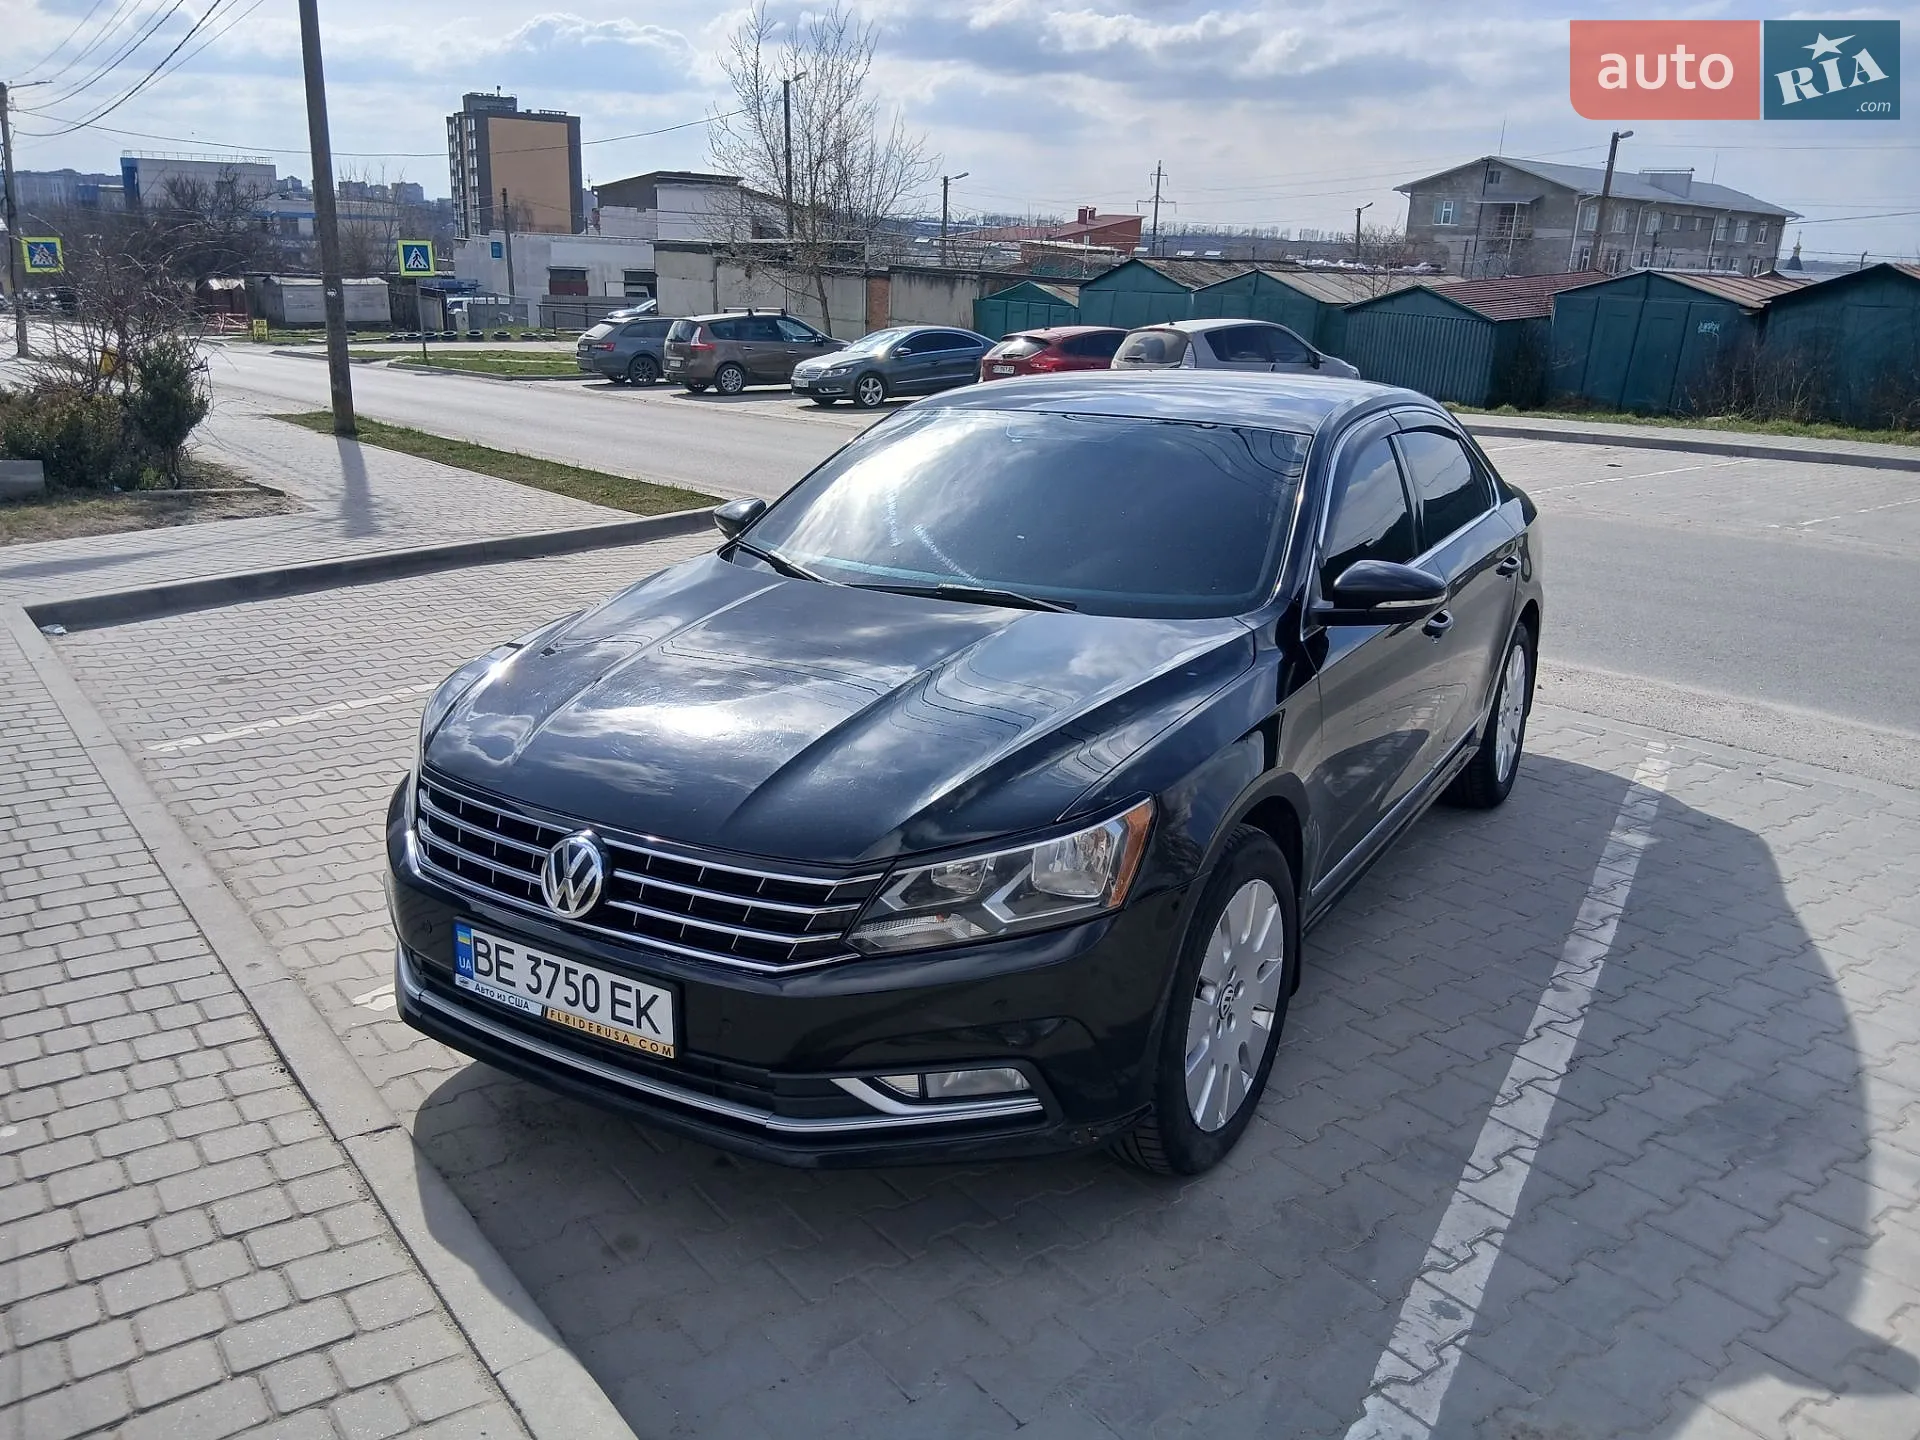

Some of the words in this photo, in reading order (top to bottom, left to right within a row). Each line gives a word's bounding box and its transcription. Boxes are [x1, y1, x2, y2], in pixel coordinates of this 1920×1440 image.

[458, 955, 471, 972] UA
[473, 936, 516, 988] BE
[526, 954, 600, 1013] 3750
[610, 980, 661, 1035] EK
[508, 996, 530, 1011] США
